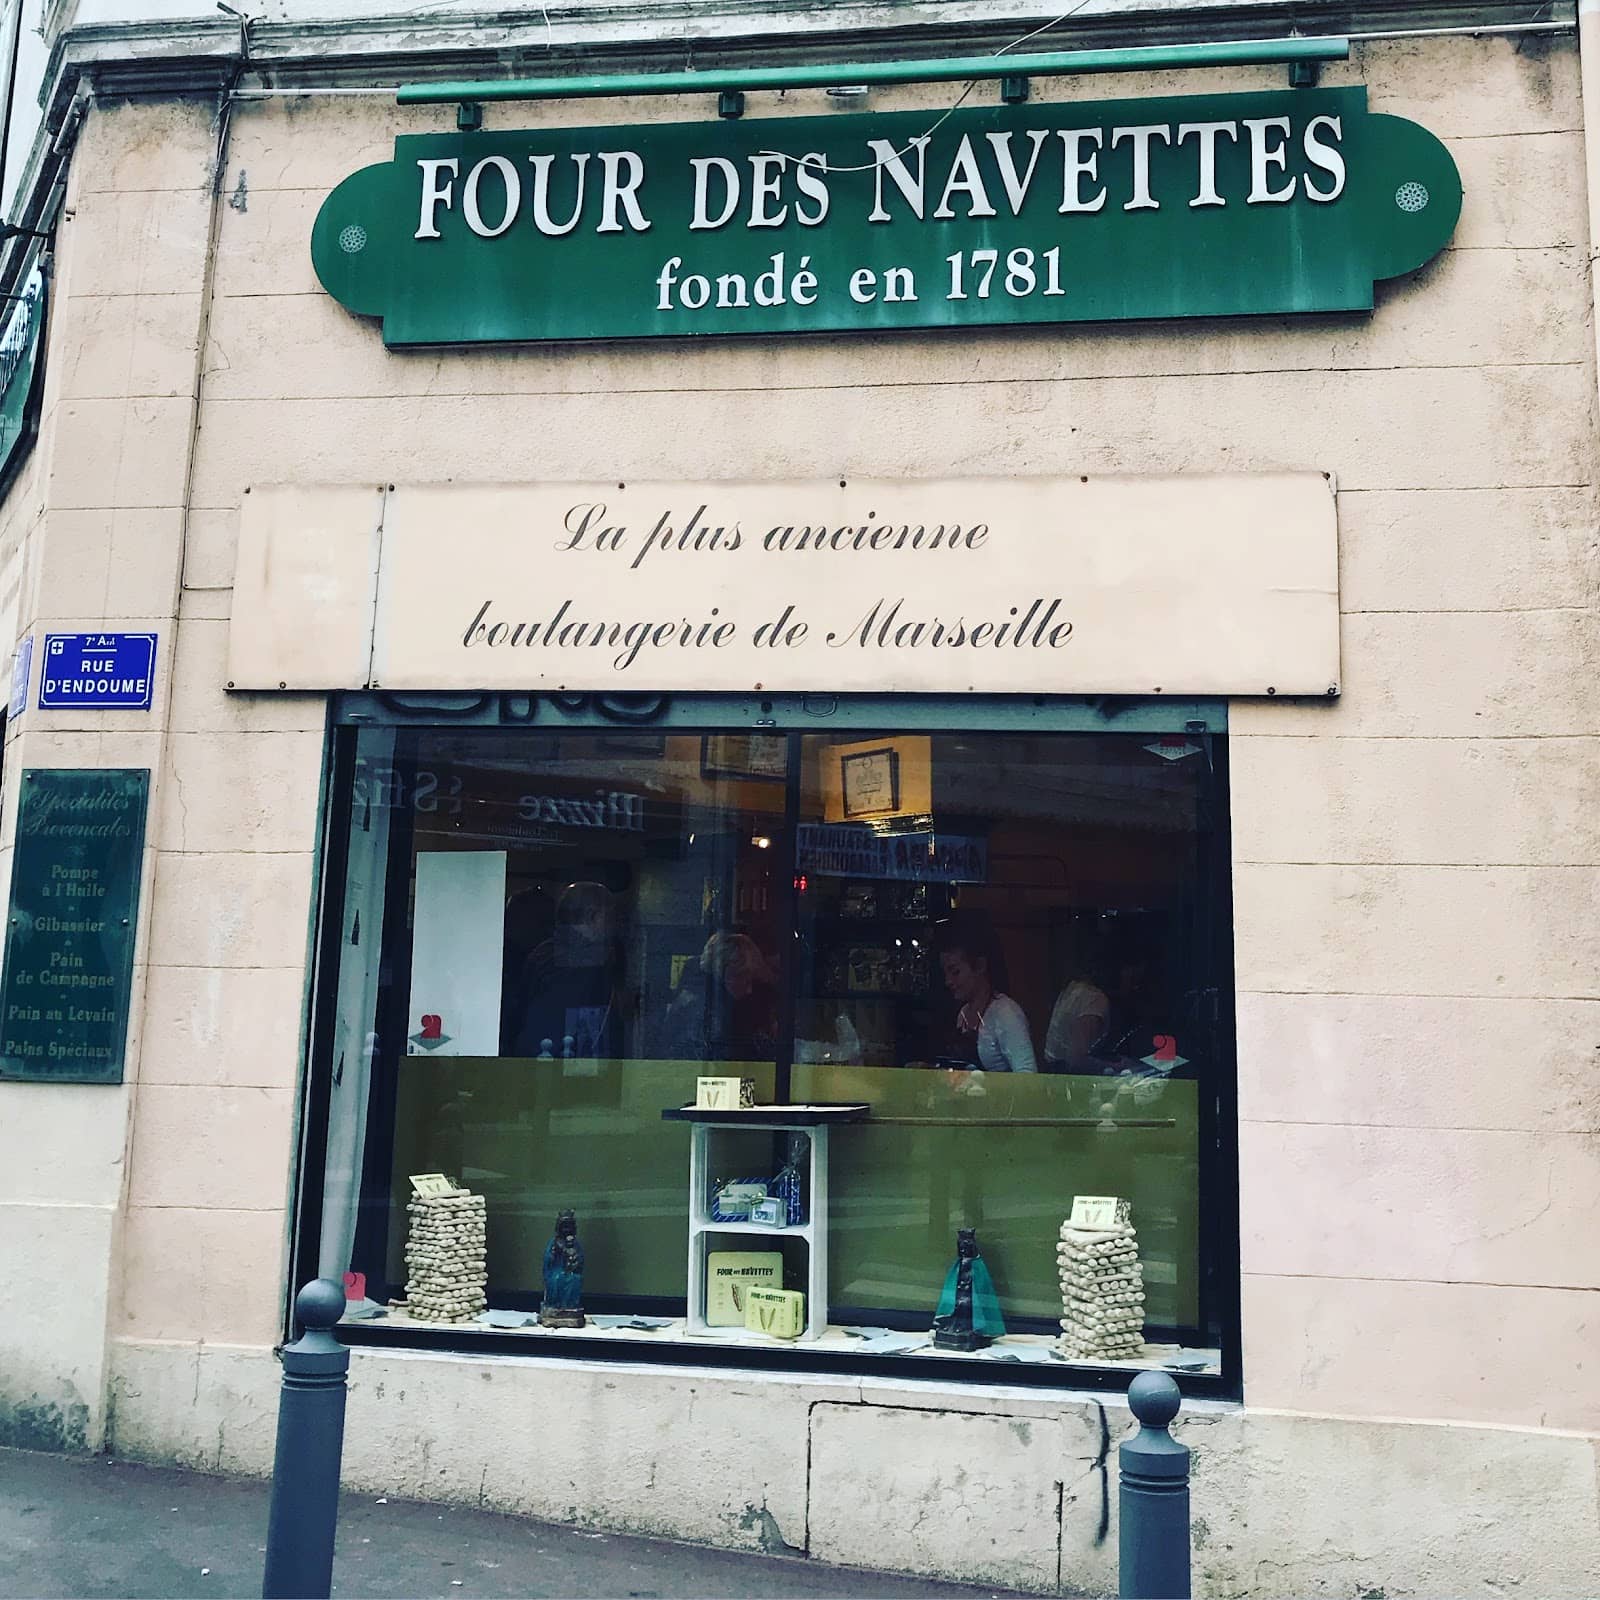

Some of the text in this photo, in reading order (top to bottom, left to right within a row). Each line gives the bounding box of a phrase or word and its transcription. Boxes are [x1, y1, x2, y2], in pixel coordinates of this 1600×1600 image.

[415, 115, 1346, 239] FOUR DES NAVETTES
[656, 246, 1066, 310] fondé en 1781
[553, 503, 990, 569] La plus ancienne
[461, 598, 1074, 671] boulangerie de Marseille
[81, 660, 115, 673] RUE
[45, 679, 146, 694] D'ENDOUME
[51, 864, 99, 881] Pompe
[34, 916, 105, 932] Gibassier
[50, 952, 84, 967] Pain
[16, 970, 115, 988] de Campagne
[8, 1005, 116, 1022] Pain au Levain
[5, 1040, 113, 1060] Pains Spéciaux
